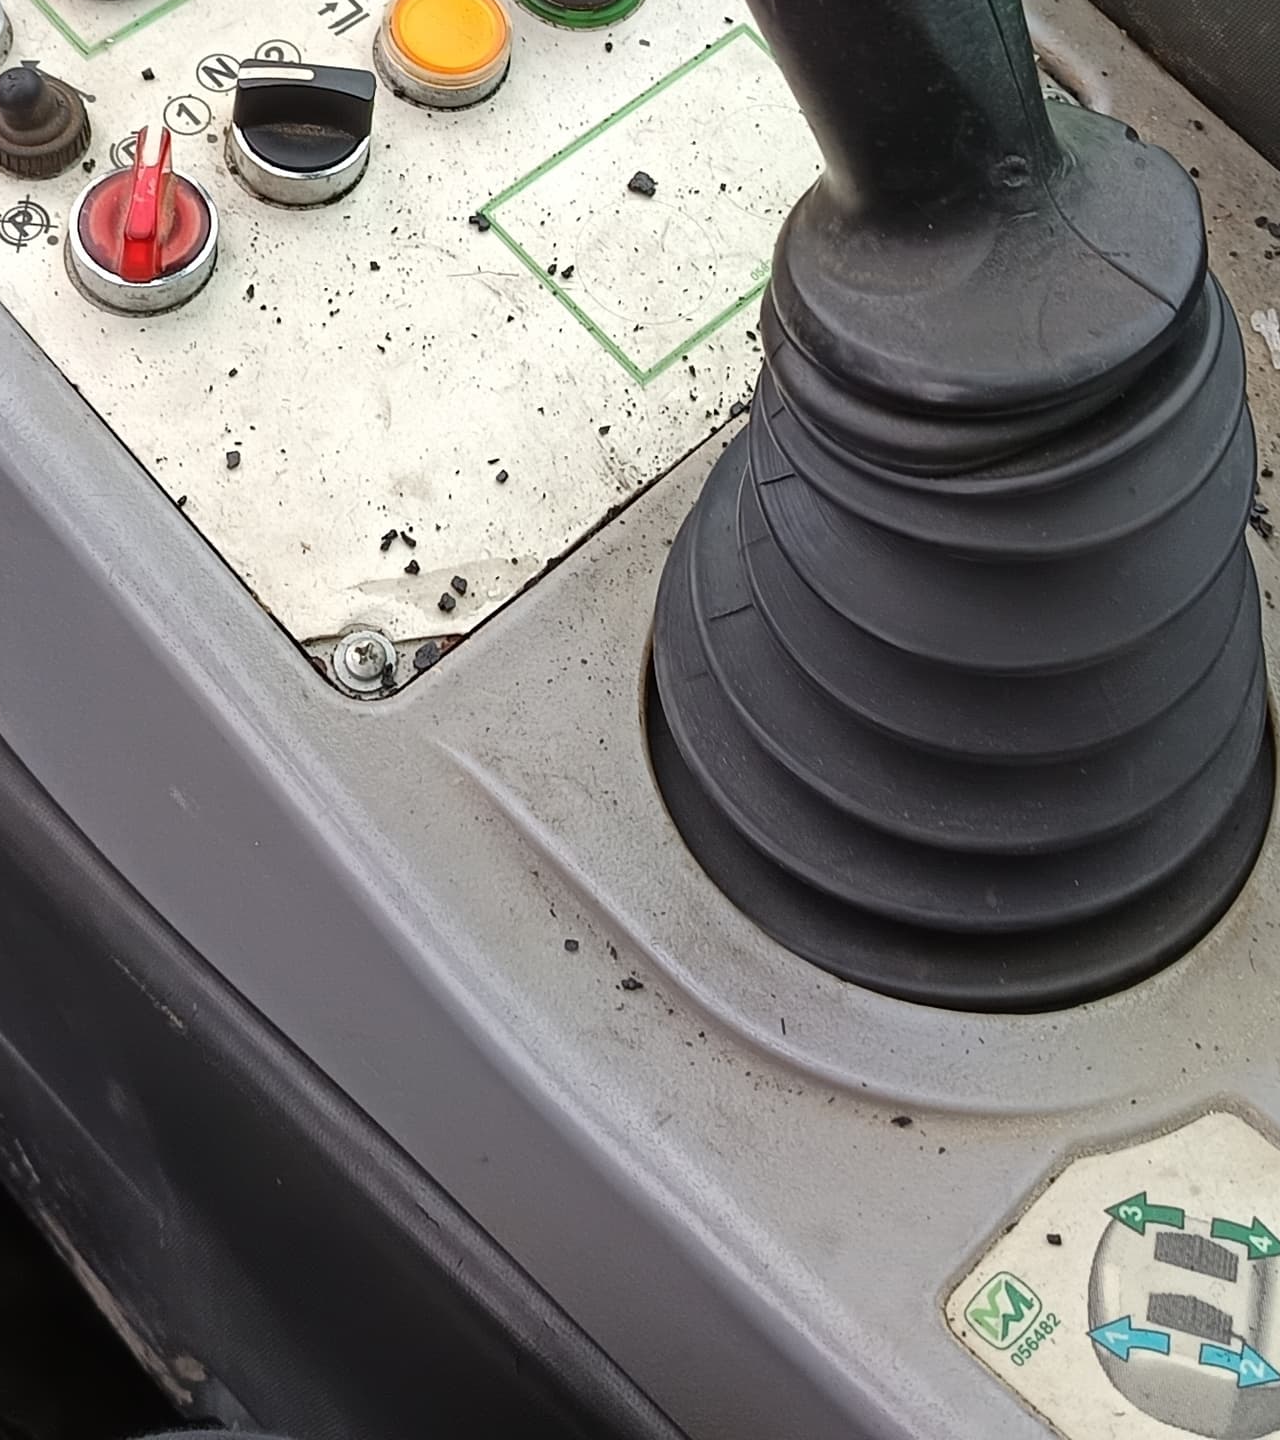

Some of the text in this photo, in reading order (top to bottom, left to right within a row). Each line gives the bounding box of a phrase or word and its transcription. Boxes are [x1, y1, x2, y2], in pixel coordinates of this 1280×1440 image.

[201, 57, 239, 88] N
[176, 102, 201, 126] 1
[1119, 1205, 1142, 1221] 3
[1249, 1234, 1273, 1253] 4
[1010, 1312, 1062, 1367] 056482
[1105, 1330, 1129, 1344] 1
[1239, 1358, 1265, 1378] 2
